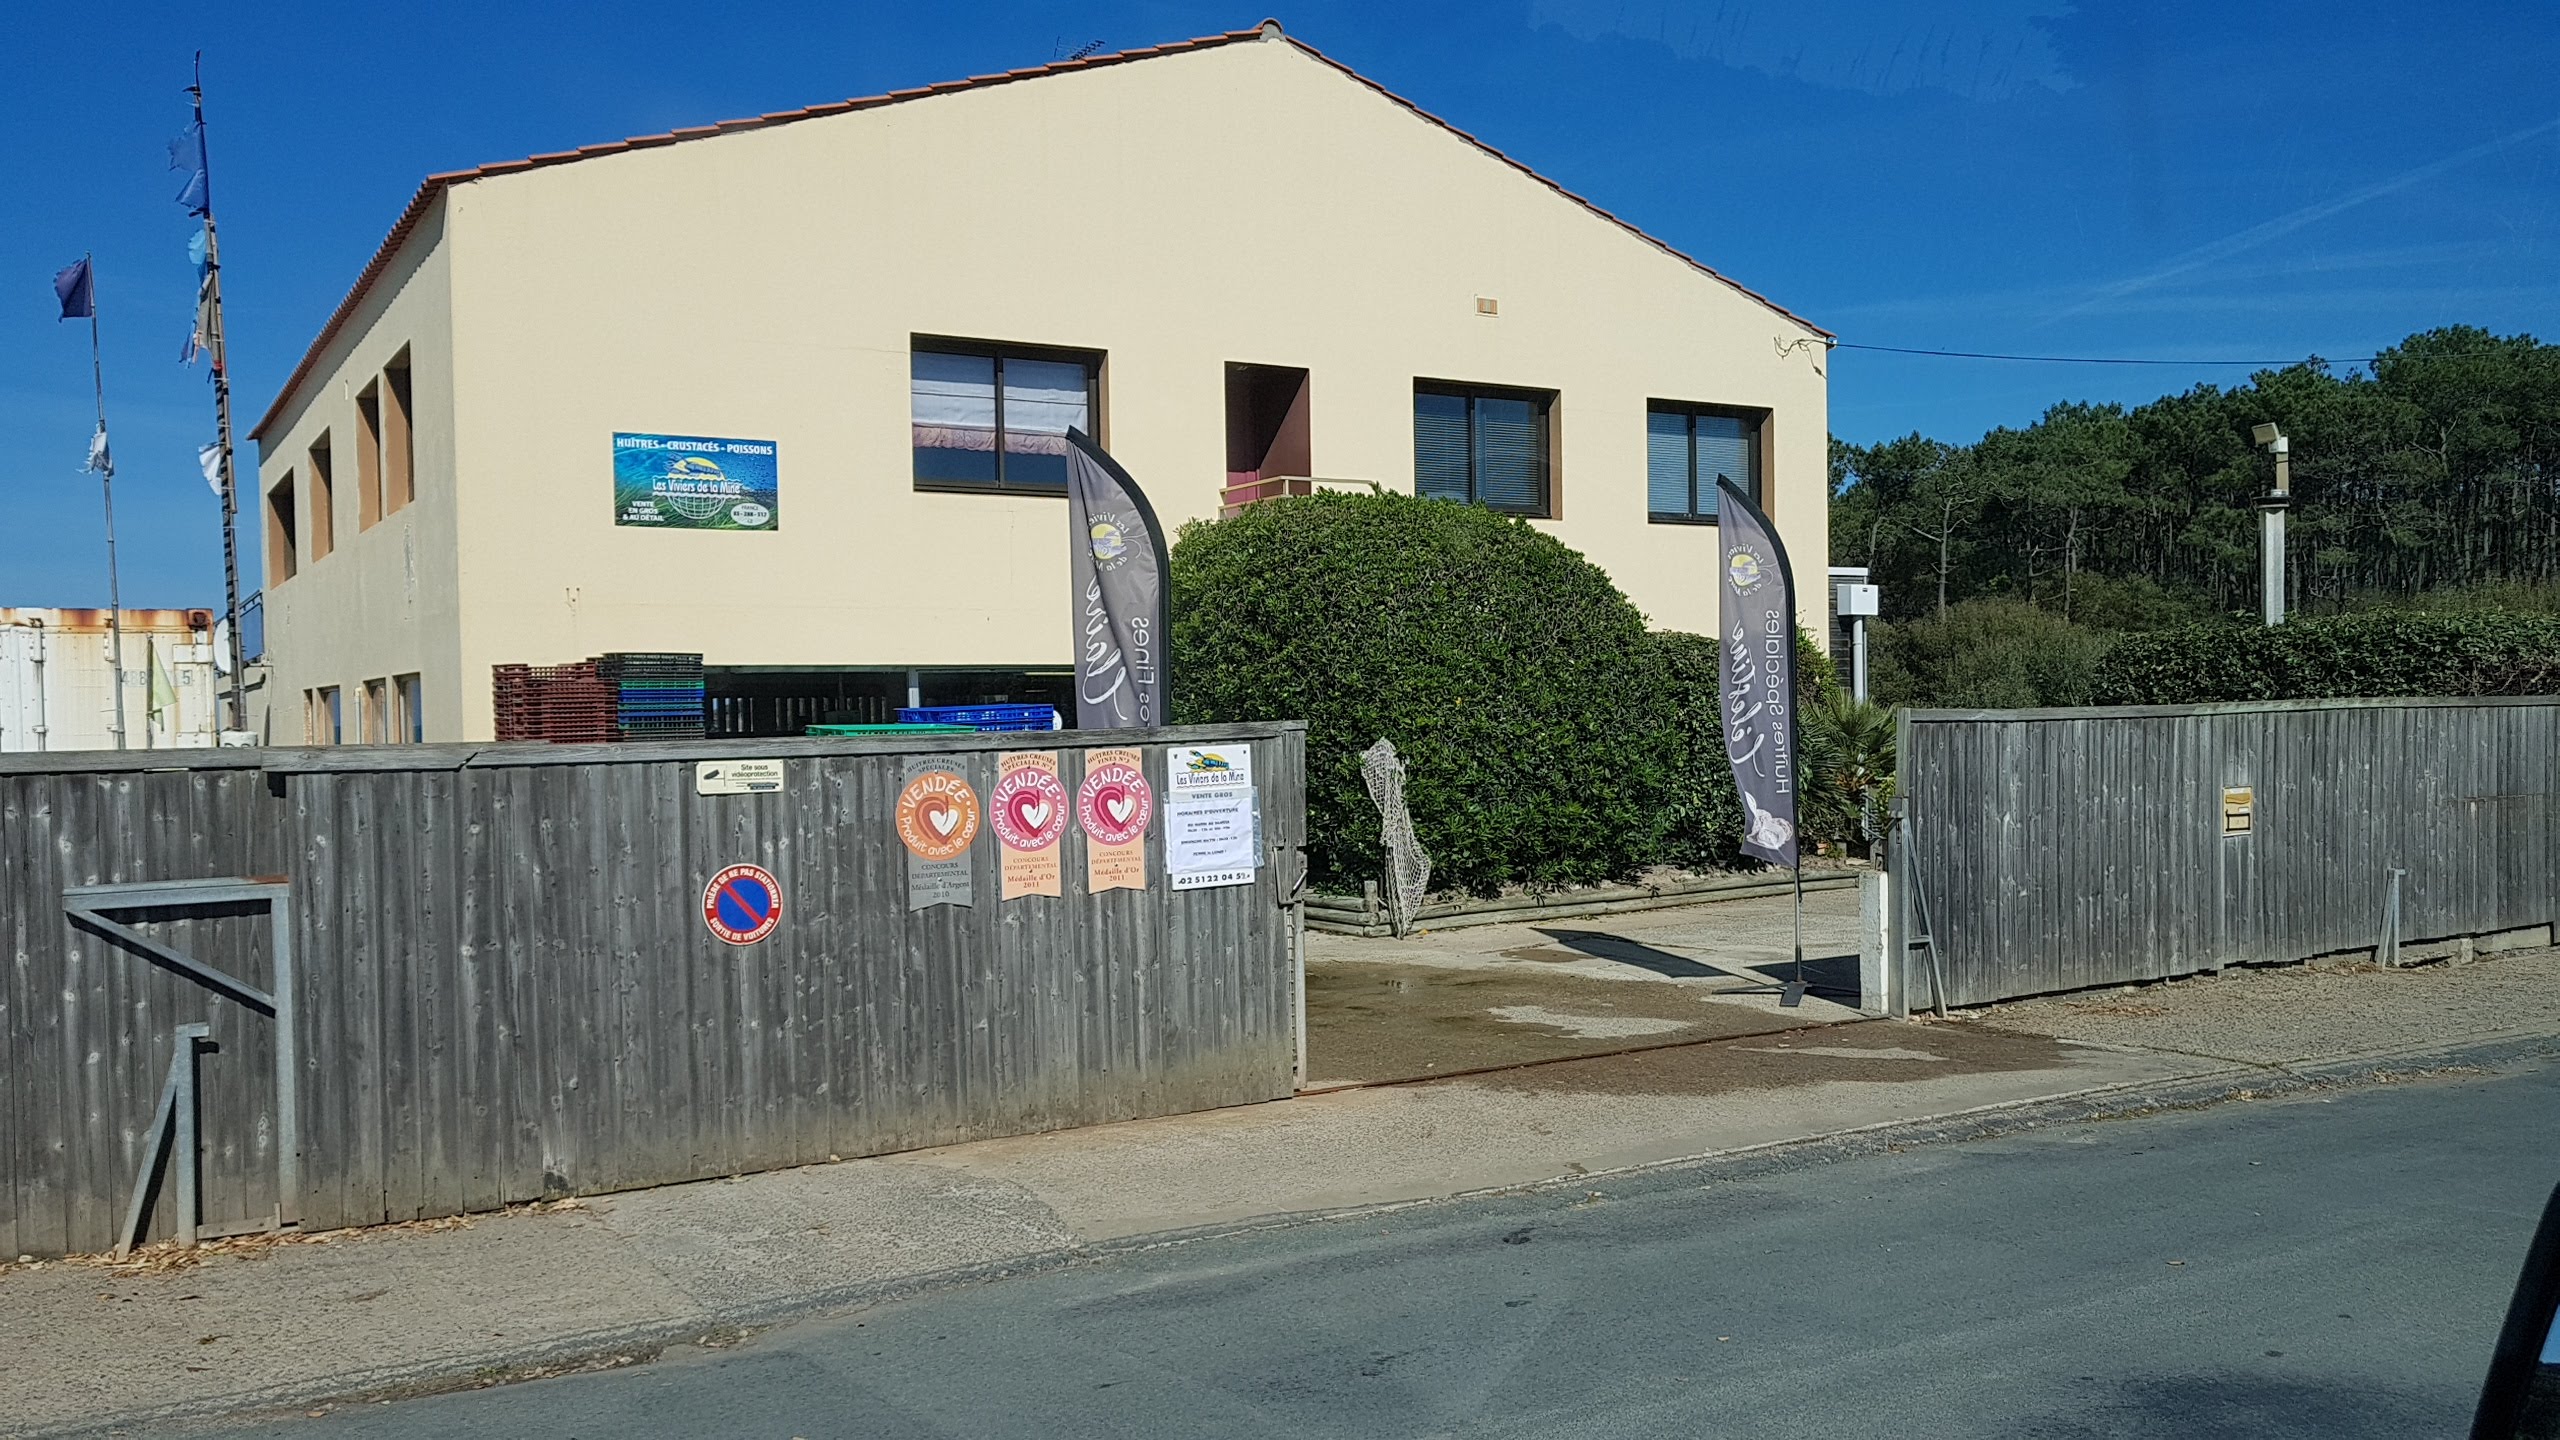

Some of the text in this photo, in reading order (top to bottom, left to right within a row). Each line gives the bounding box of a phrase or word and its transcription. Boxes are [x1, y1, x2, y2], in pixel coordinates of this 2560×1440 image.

[617, 437, 659, 449] HUÎTRES
[667, 440, 720, 452] CRUSTACÉS
[727, 444, 773, 455] POISSONS
[653, 478, 666, 491] Les
[668, 479, 695, 492] Viviers
[697, 480, 708, 492] de
[710, 480, 718, 493] la
[632, 500, 655, 508] VENTE
[936, 757, 966, 770] CREUSES
[1029, 753, 1056, 767] CREUSES
[1114, 750, 1140, 762] CREUSES
[1083, 767, 1144, 798] VENDÉE
[1177, 774, 1187, 785] Les
[1211, 772, 1219, 782] de
[1221, 771, 1227, 782] la
[901, 776, 970, 809] VENDÉE
[996, 771, 1060, 802] VENDÉE
[994, 809, 1019, 844] Produit
[1020, 836, 1044, 848] avec
[1043, 831, 1054, 841] le
[1081, 804, 1105, 838] Produit
[1105, 831, 1129, 842] avec
[1128, 825, 1138, 835] le
[900, 816, 927, 852] Produit
[927, 844, 954, 856] avec
[953, 837, 964, 848] le
[740, 868, 755, 876] PAS
[921, 862, 959, 870] CONCOURS
[1180, 877, 1192, 885] 02
[710, 917, 775, 940] SORTIE DE VOITURES
